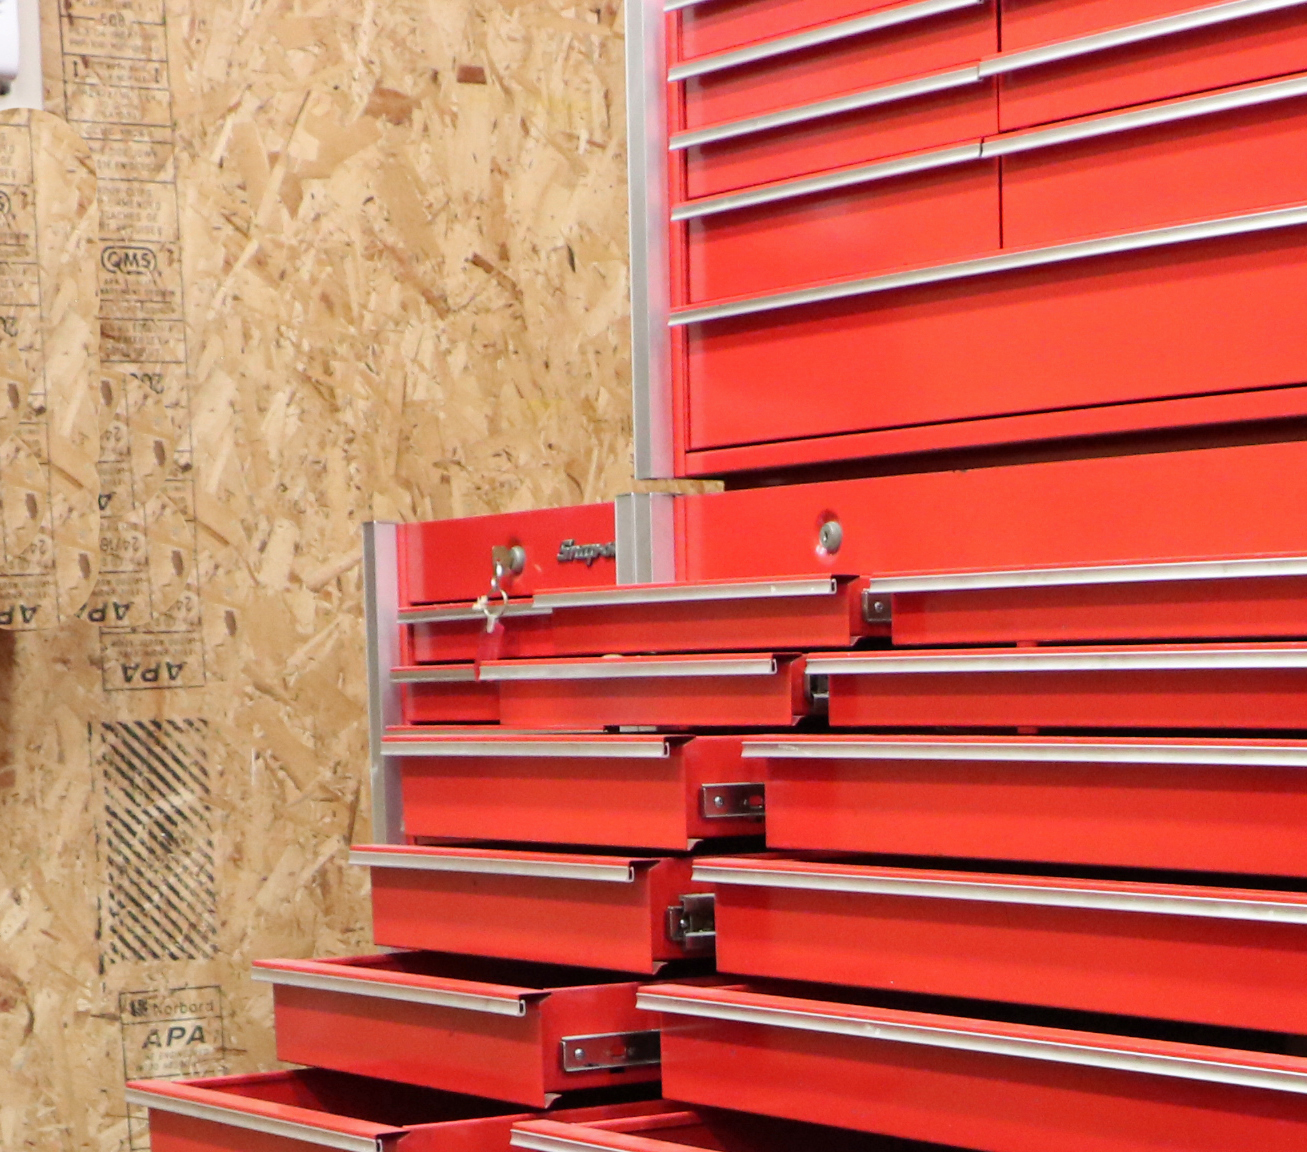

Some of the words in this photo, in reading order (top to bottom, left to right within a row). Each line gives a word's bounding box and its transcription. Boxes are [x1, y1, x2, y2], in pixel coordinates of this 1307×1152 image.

[107, 251, 151, 270] QMS
[557, 538, 616, 567] Snap-o
[121, 661, 187, 683] APA
[141, 1025, 206, 1049] APA
